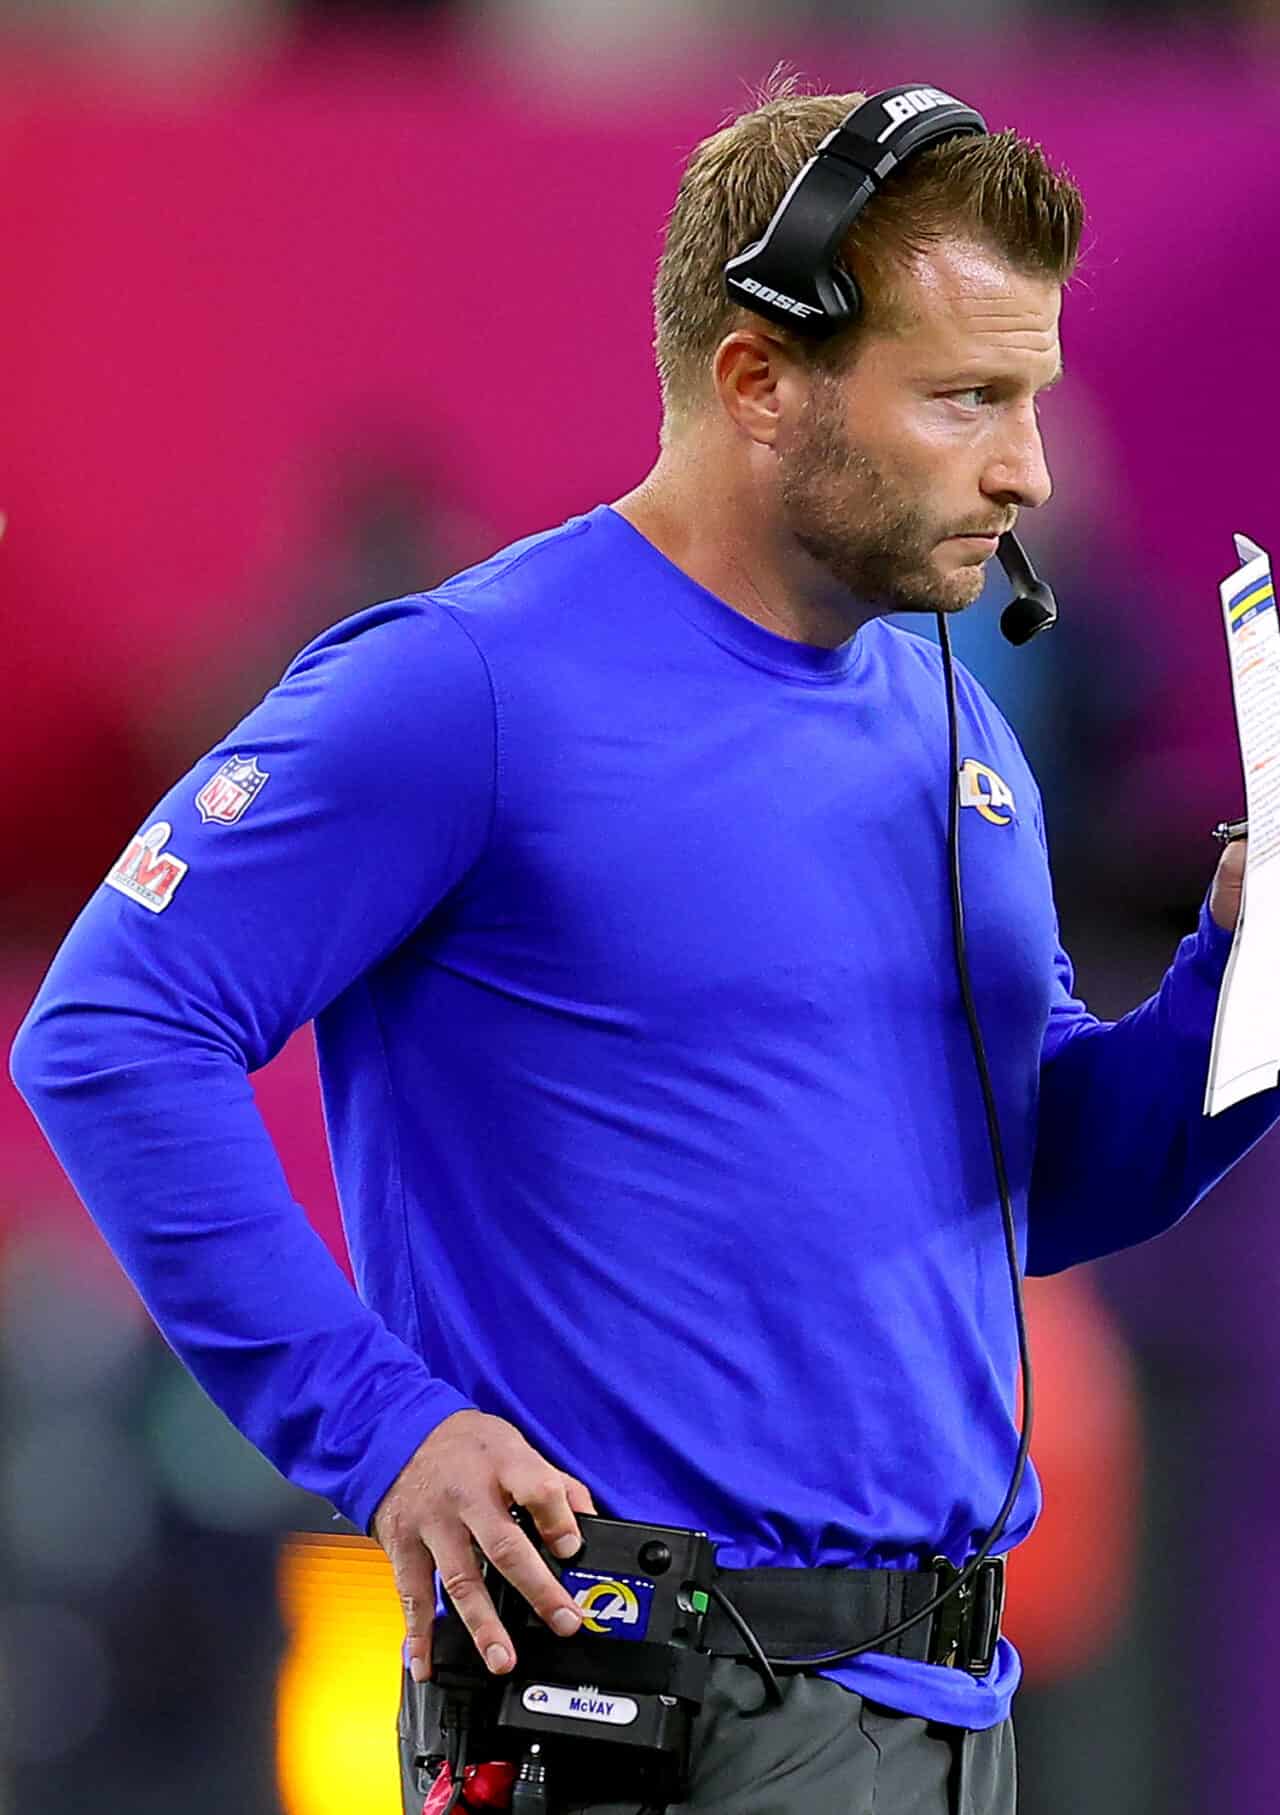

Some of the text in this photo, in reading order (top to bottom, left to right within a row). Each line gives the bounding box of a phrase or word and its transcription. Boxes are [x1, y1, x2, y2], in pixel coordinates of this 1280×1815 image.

[728, 277, 824, 318] BOSE
[202, 777, 244, 818] NFL
[569, 1697, 615, 1717] McVAY
